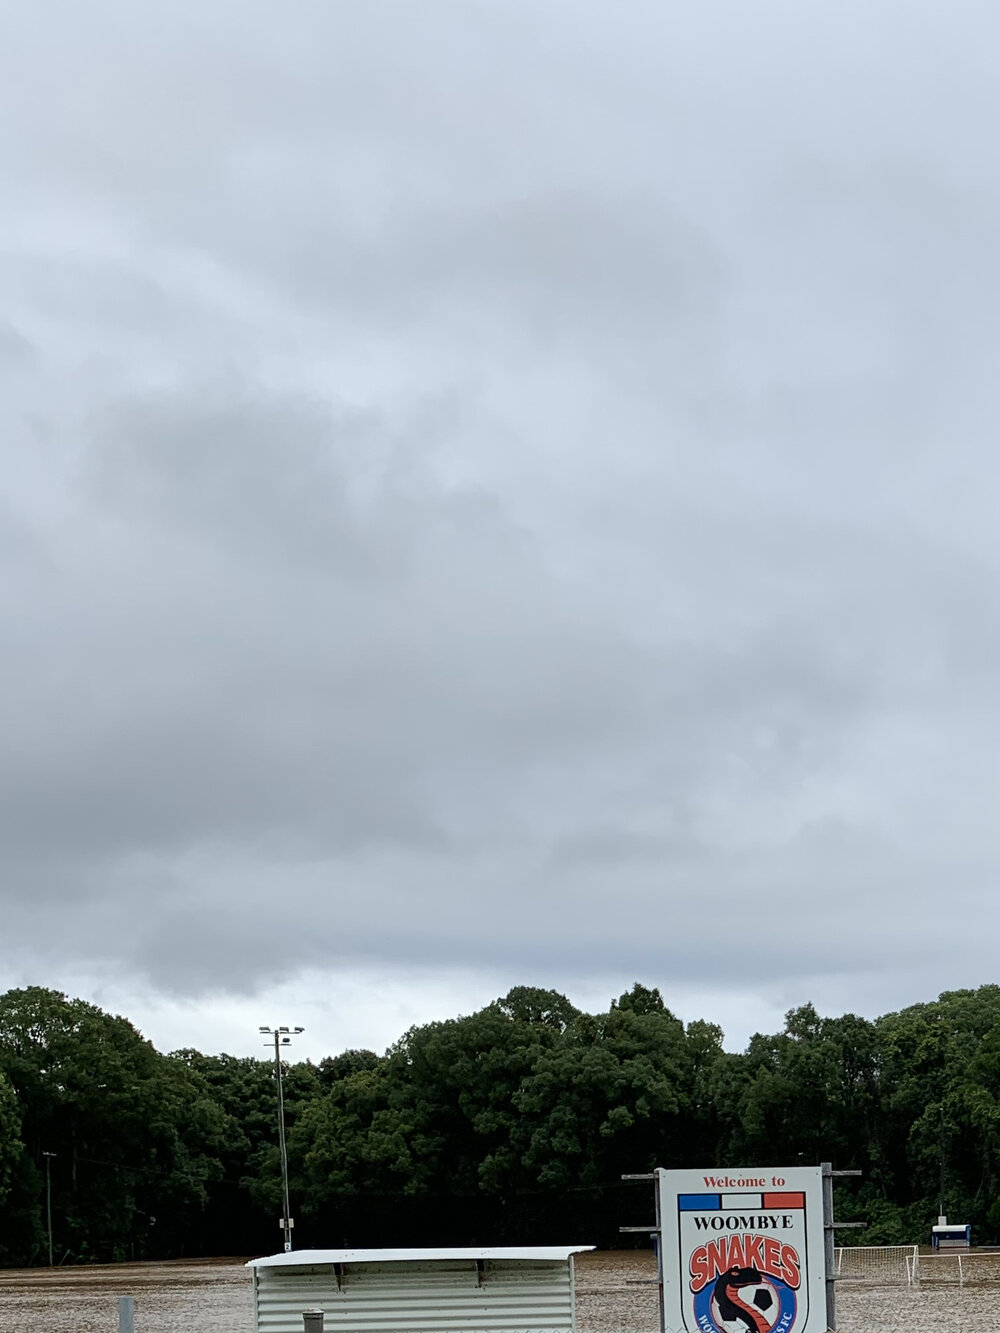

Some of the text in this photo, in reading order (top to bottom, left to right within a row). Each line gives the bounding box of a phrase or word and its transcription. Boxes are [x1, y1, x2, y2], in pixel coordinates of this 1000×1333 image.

[703, 1176, 786, 1188] Welcome to
[693, 1215, 793, 1230] WOOMBYE
[689, 1233, 801, 1294] SNAKES
[780, 1312, 793, 1328] FC
